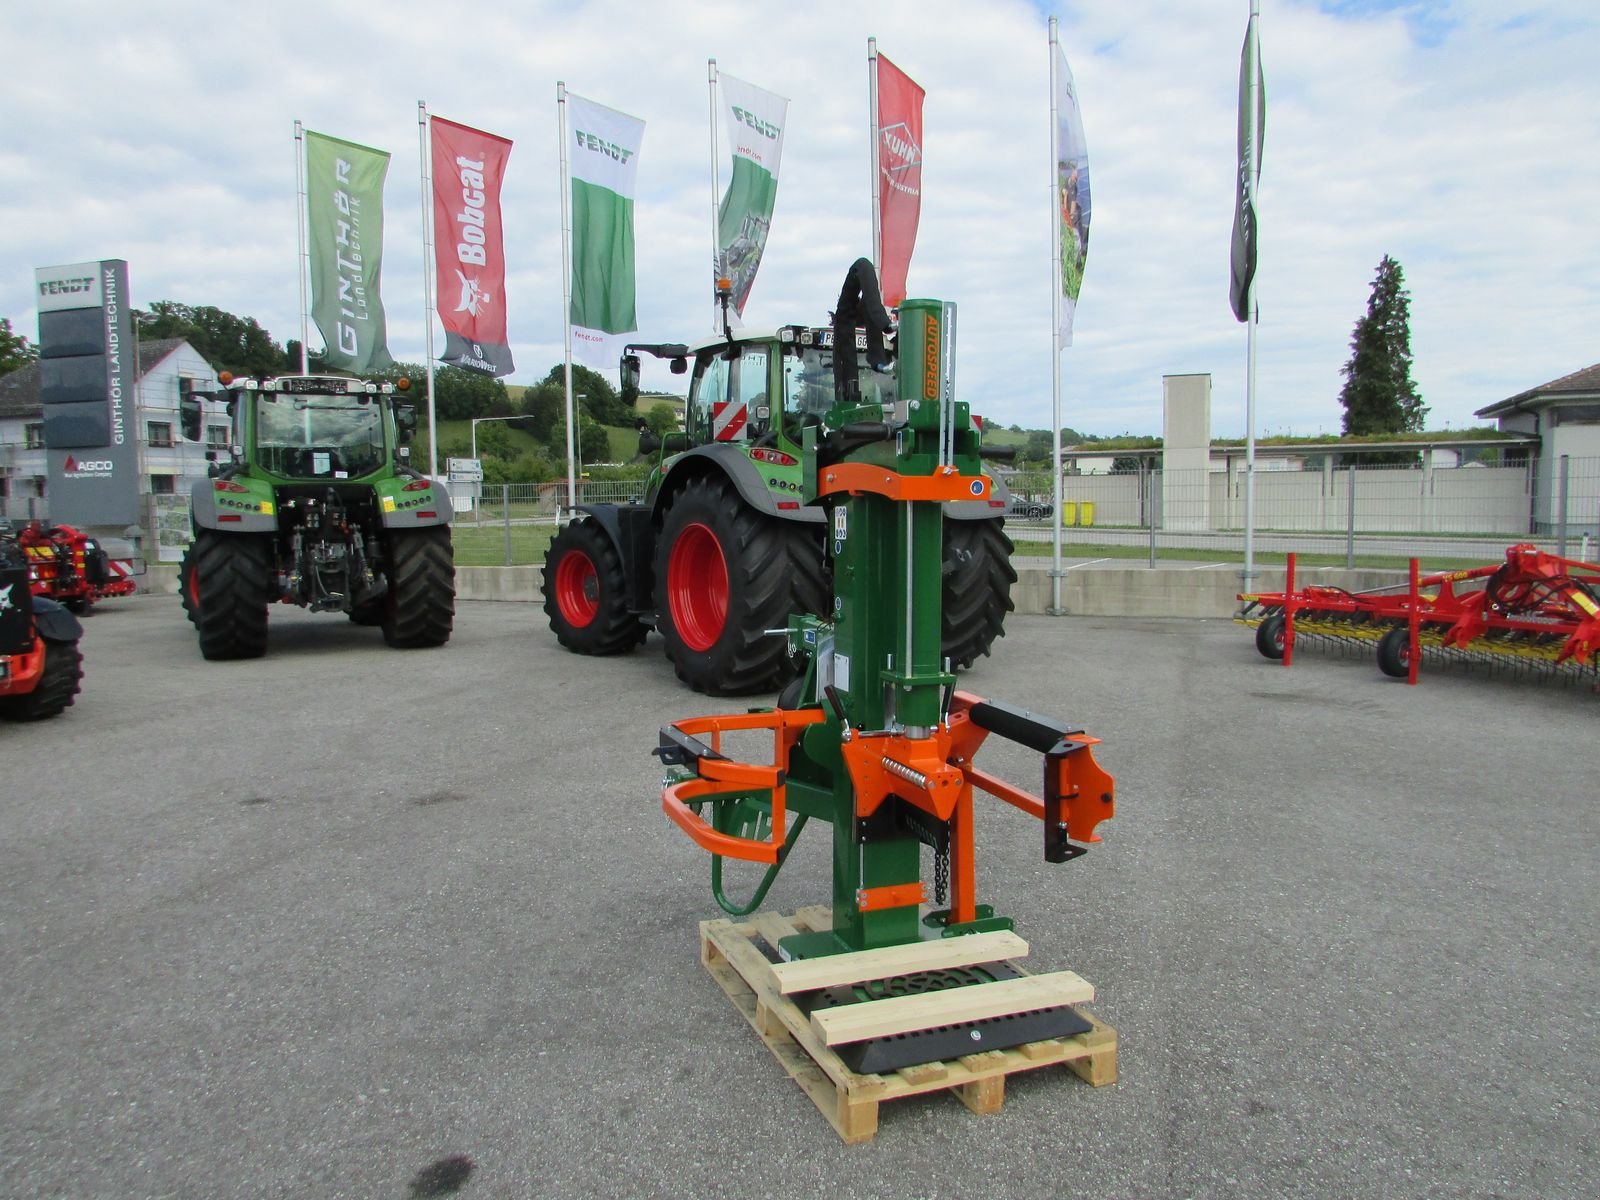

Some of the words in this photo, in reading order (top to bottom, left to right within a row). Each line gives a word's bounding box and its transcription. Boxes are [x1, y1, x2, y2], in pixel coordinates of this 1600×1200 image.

[575, 129, 634, 165] FENDT
[456, 155, 487, 267] Bobcat
[39, 278, 94, 296] FENDT
[334, 158, 360, 357] GINTHÖR
[105, 268, 120, 374] LANDTECHNIK
[925, 314, 939, 399] AUTOSPEED
[112, 377, 124, 445] GINTHÖR
[78, 460, 113, 471] AGCO
